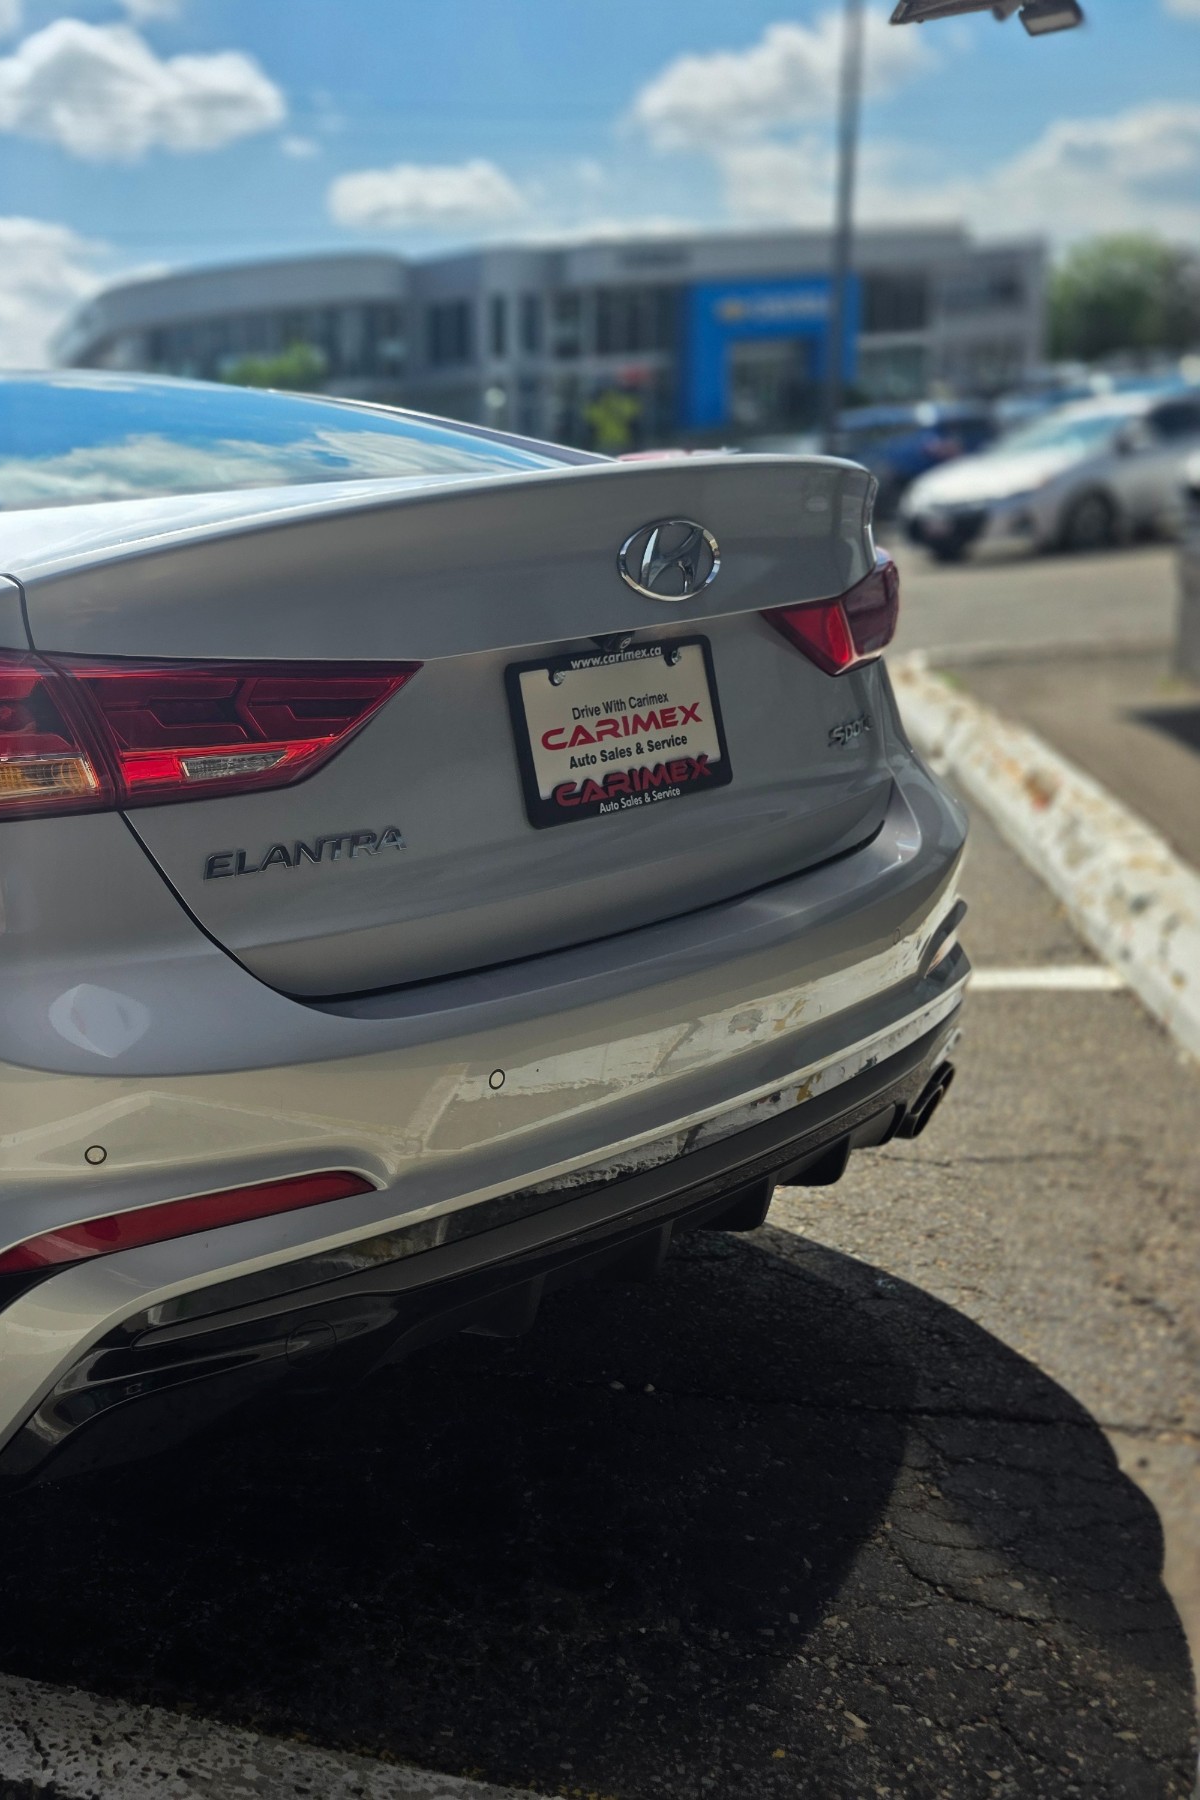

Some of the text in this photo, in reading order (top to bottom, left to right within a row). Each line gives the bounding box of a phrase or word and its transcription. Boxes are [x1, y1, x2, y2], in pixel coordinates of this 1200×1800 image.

[571, 647, 661, 669] www.carimex.ca
[572, 691, 669, 720] Drive With Carimex
[541, 702, 703, 751] CARIMEX
[569, 733, 688, 769] Auto Sales & Service
[552, 753, 712, 807] CARIMEX
[599, 786, 681, 814] Auto Sales & Service
[203, 827, 407, 881] ELANTRA
